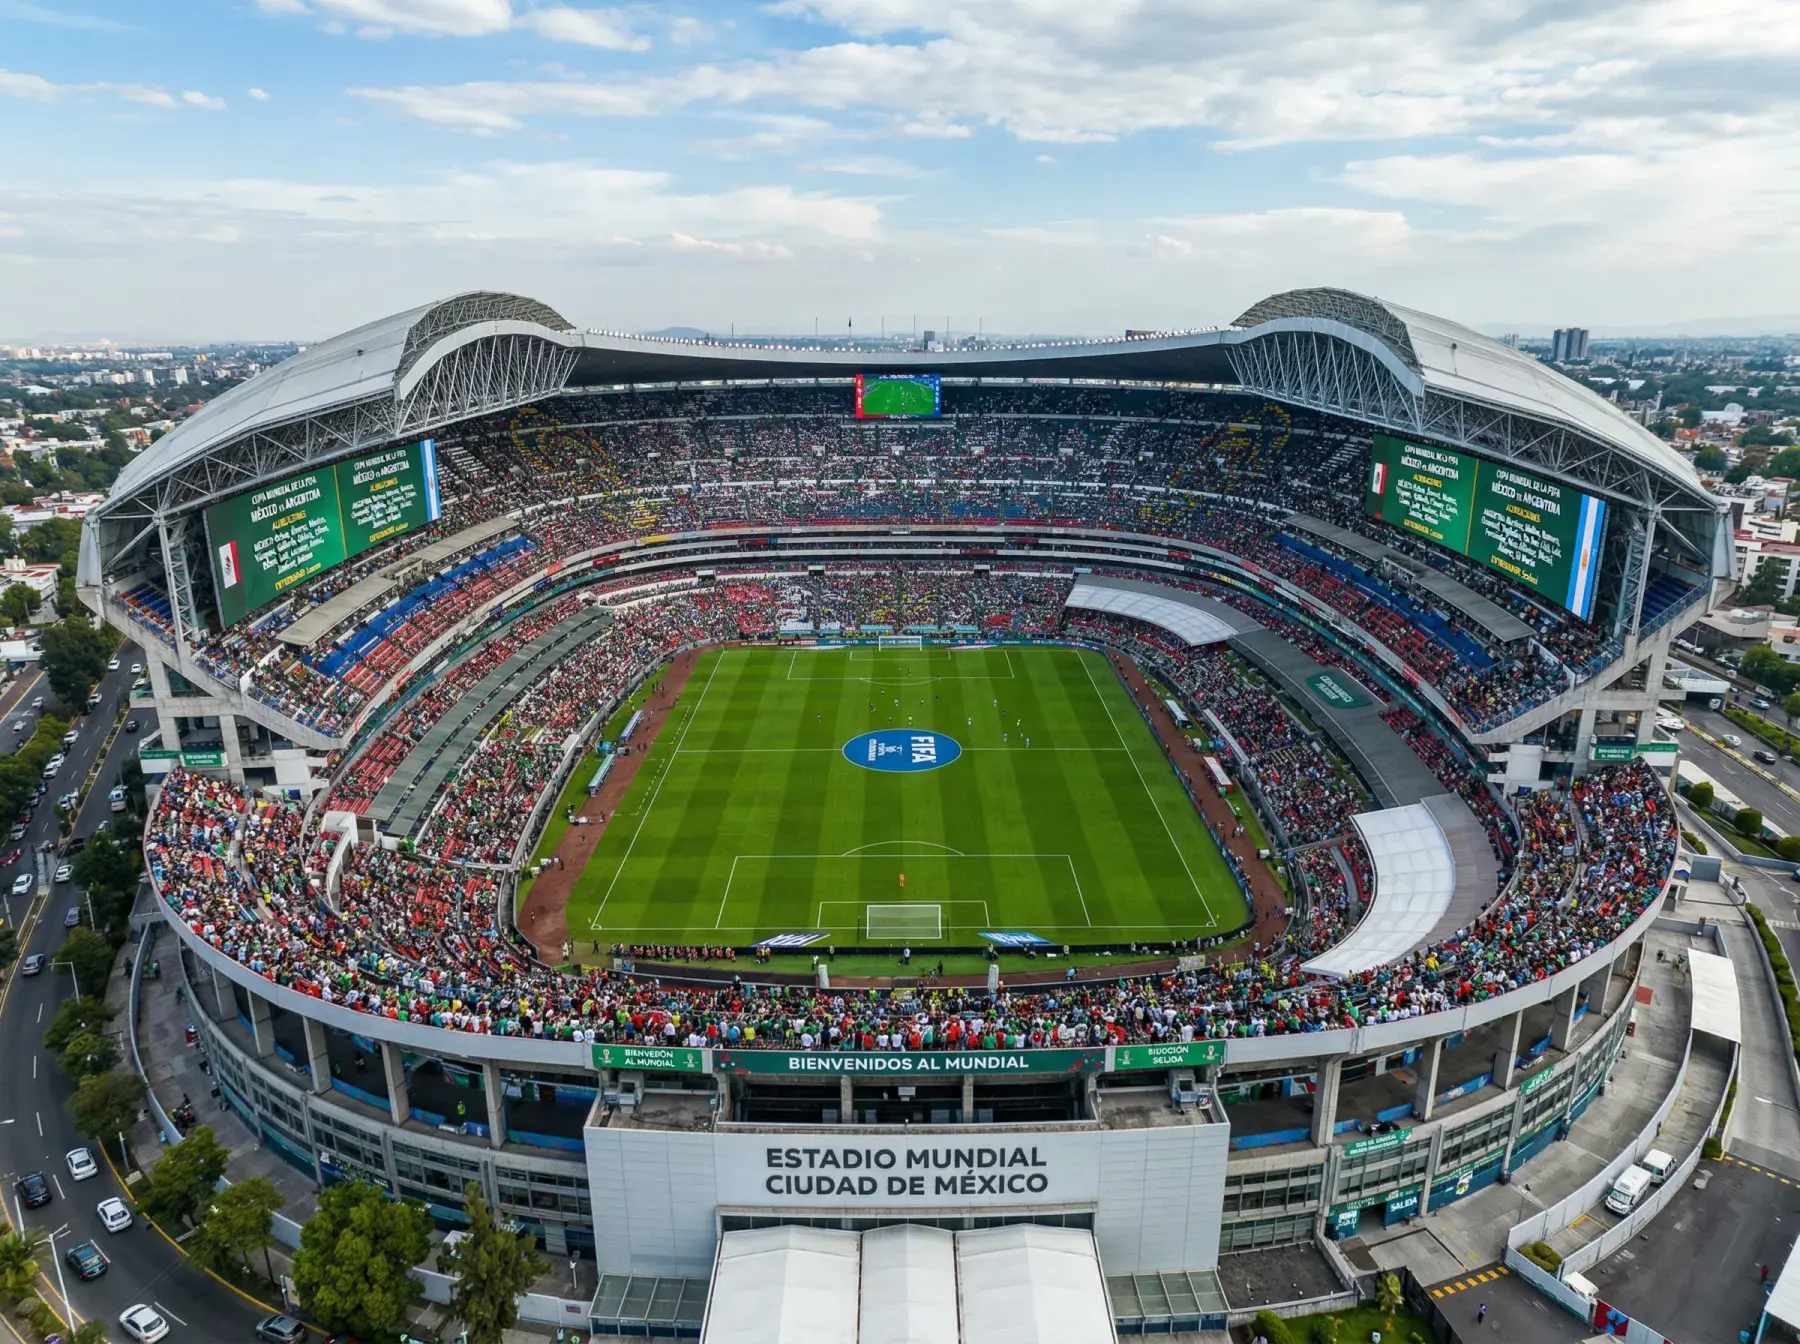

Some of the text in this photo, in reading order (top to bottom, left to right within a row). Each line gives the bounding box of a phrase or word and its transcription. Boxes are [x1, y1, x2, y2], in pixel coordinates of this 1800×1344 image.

[911, 736, 937, 763] FIFA
[624, 1057, 675, 1067] AL MUNDIAL
[789, 1056, 1029, 1070] BIENVENIDOS AL MUNDIAL
[766, 1147, 1047, 1169] ESTADIO MUNDIAL
[765, 1170, 1048, 1195] CIUDAD DE MÉXICO
